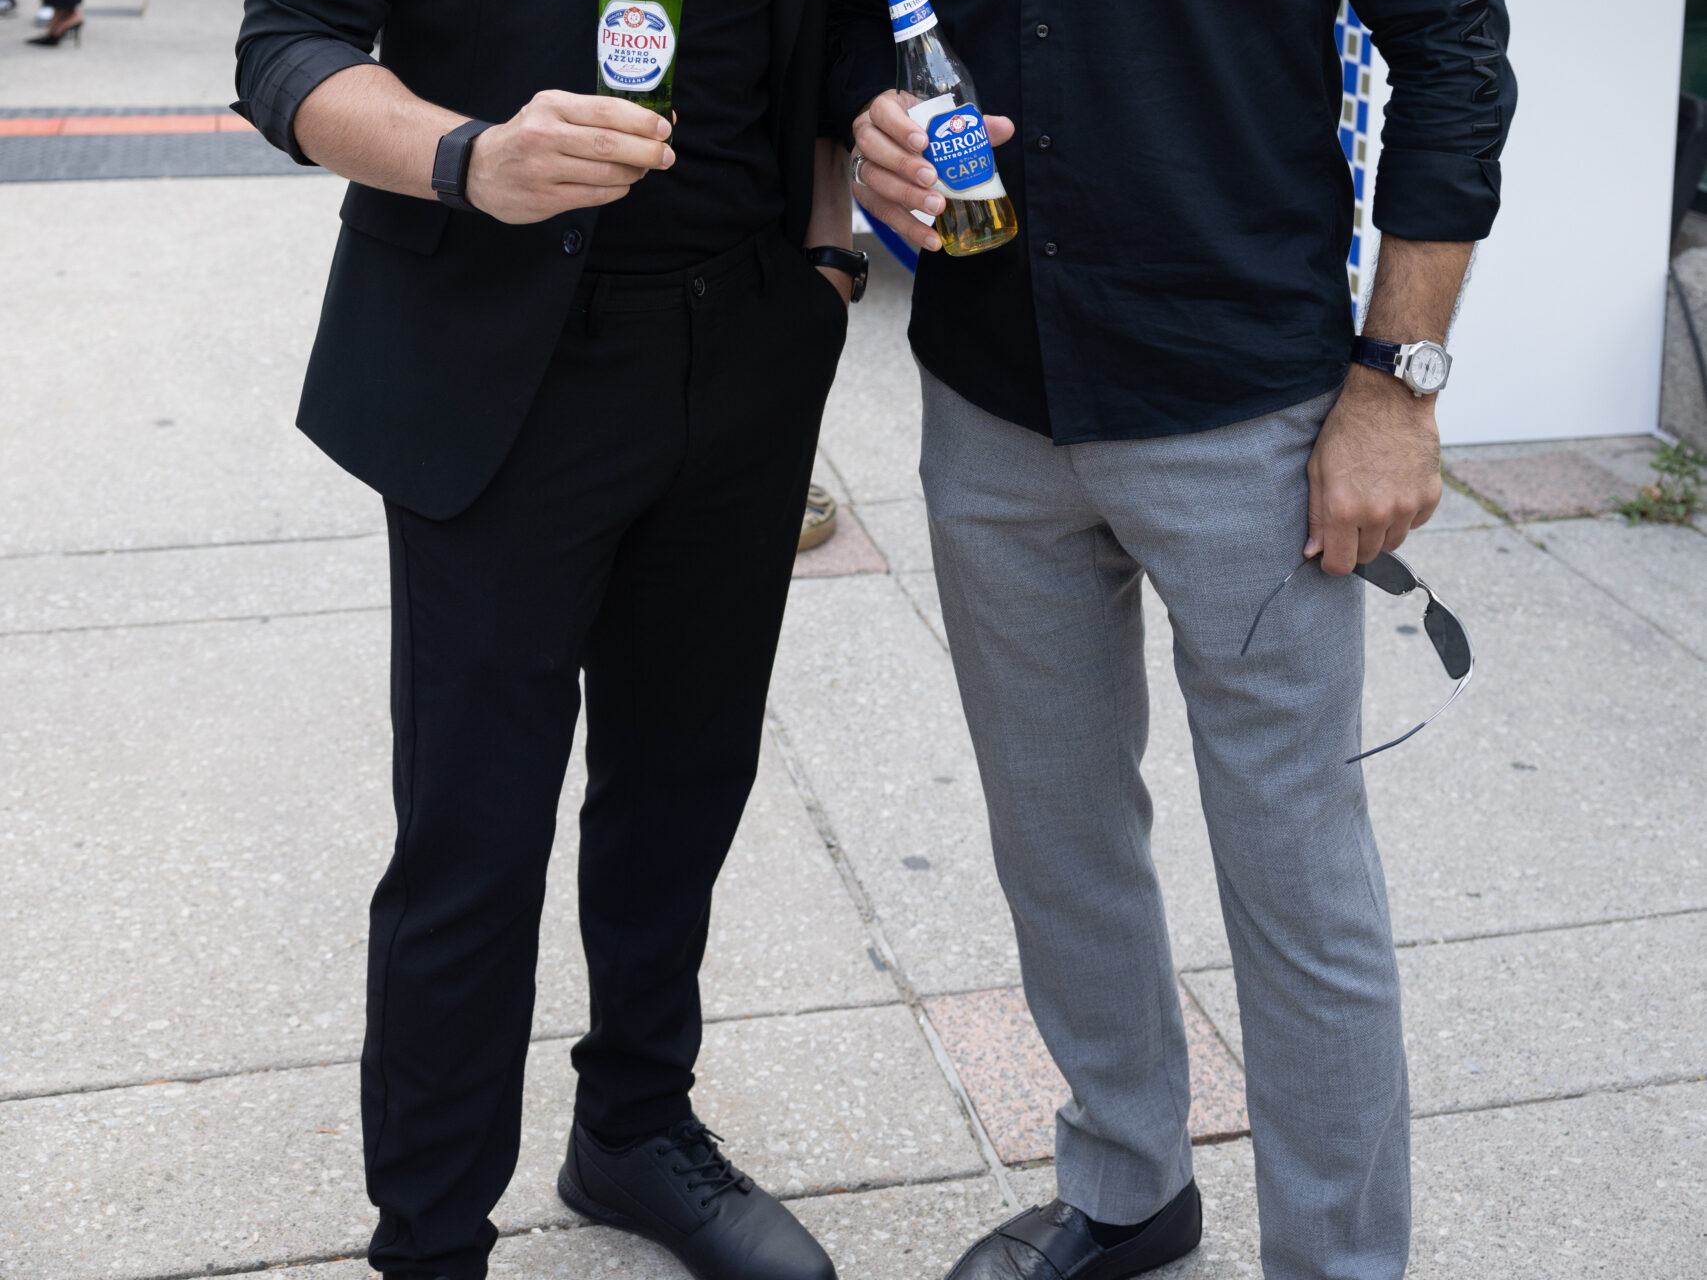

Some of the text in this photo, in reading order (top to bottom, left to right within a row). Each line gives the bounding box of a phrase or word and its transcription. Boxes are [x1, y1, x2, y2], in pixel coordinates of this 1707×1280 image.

[602, 28, 667, 49] PERONI
[608, 54, 657, 64] AZZURRO
[614, 49, 649, 57] NASTRO
[614, 74, 646, 83] ITALIANA
[929, 125, 987, 157] PERONI
[934, 139, 989, 163] NASTRO AZZURRO
[946, 153, 992, 180] CAPRI
